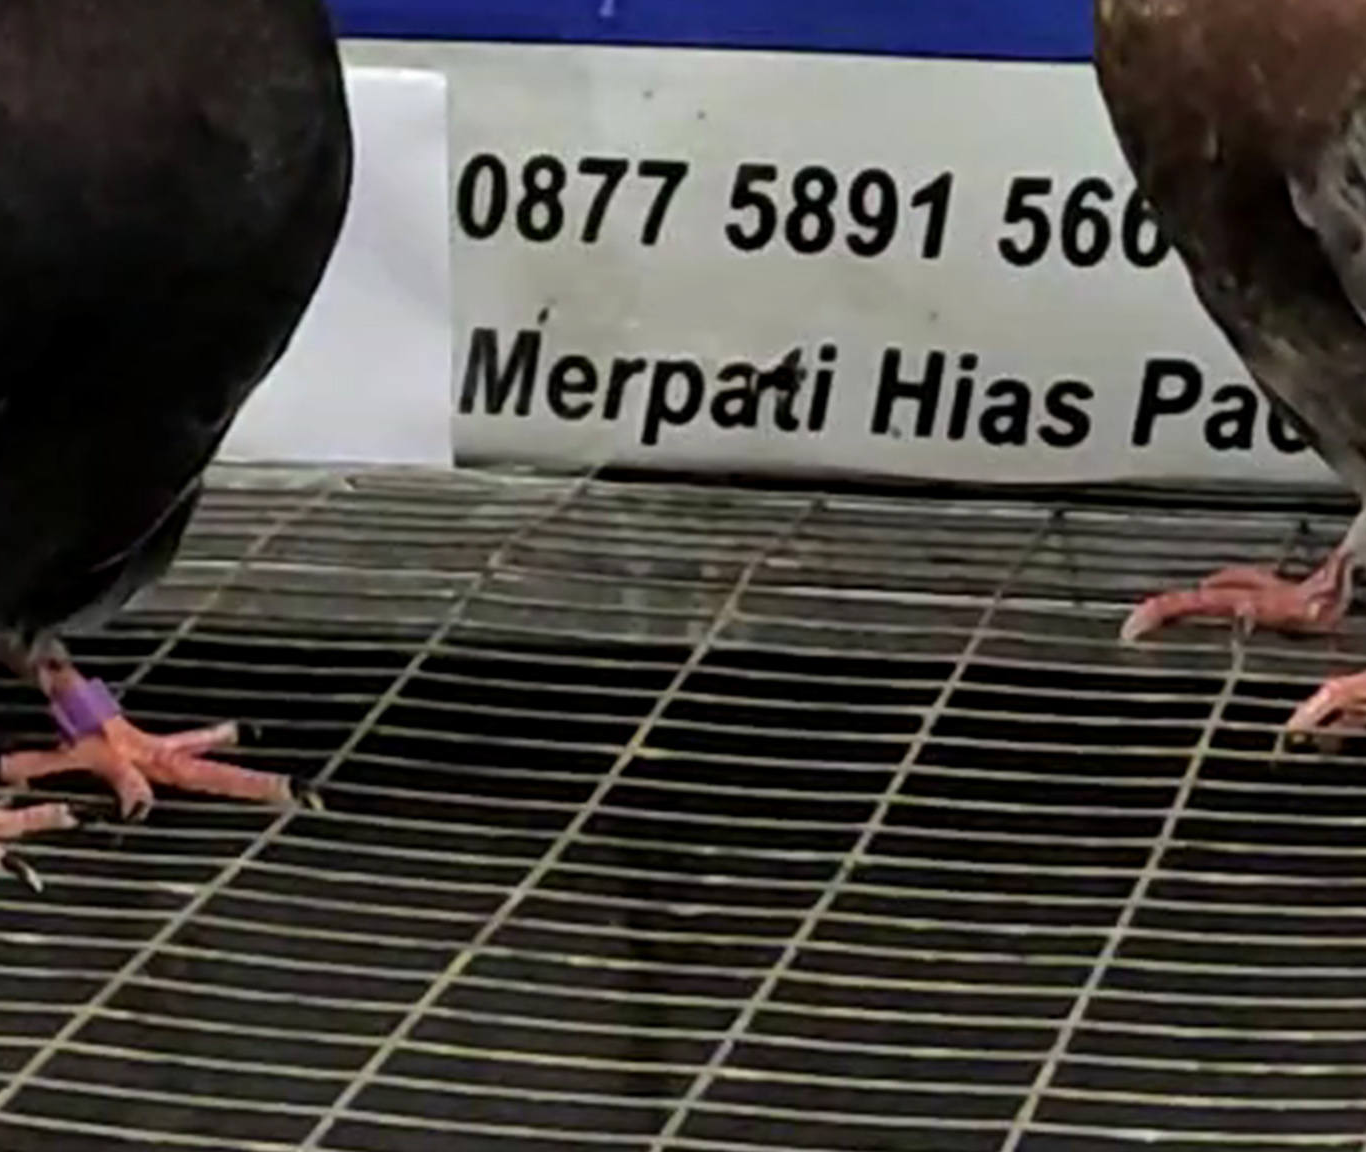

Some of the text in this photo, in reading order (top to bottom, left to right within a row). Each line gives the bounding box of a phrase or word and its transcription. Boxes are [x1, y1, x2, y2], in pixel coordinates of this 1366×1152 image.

[455, 153, 688, 246] 0877
[723, 165, 954, 259] 5891
[458, 328, 837, 446] Merpati
[870, 348, 1094, 449] Hias
